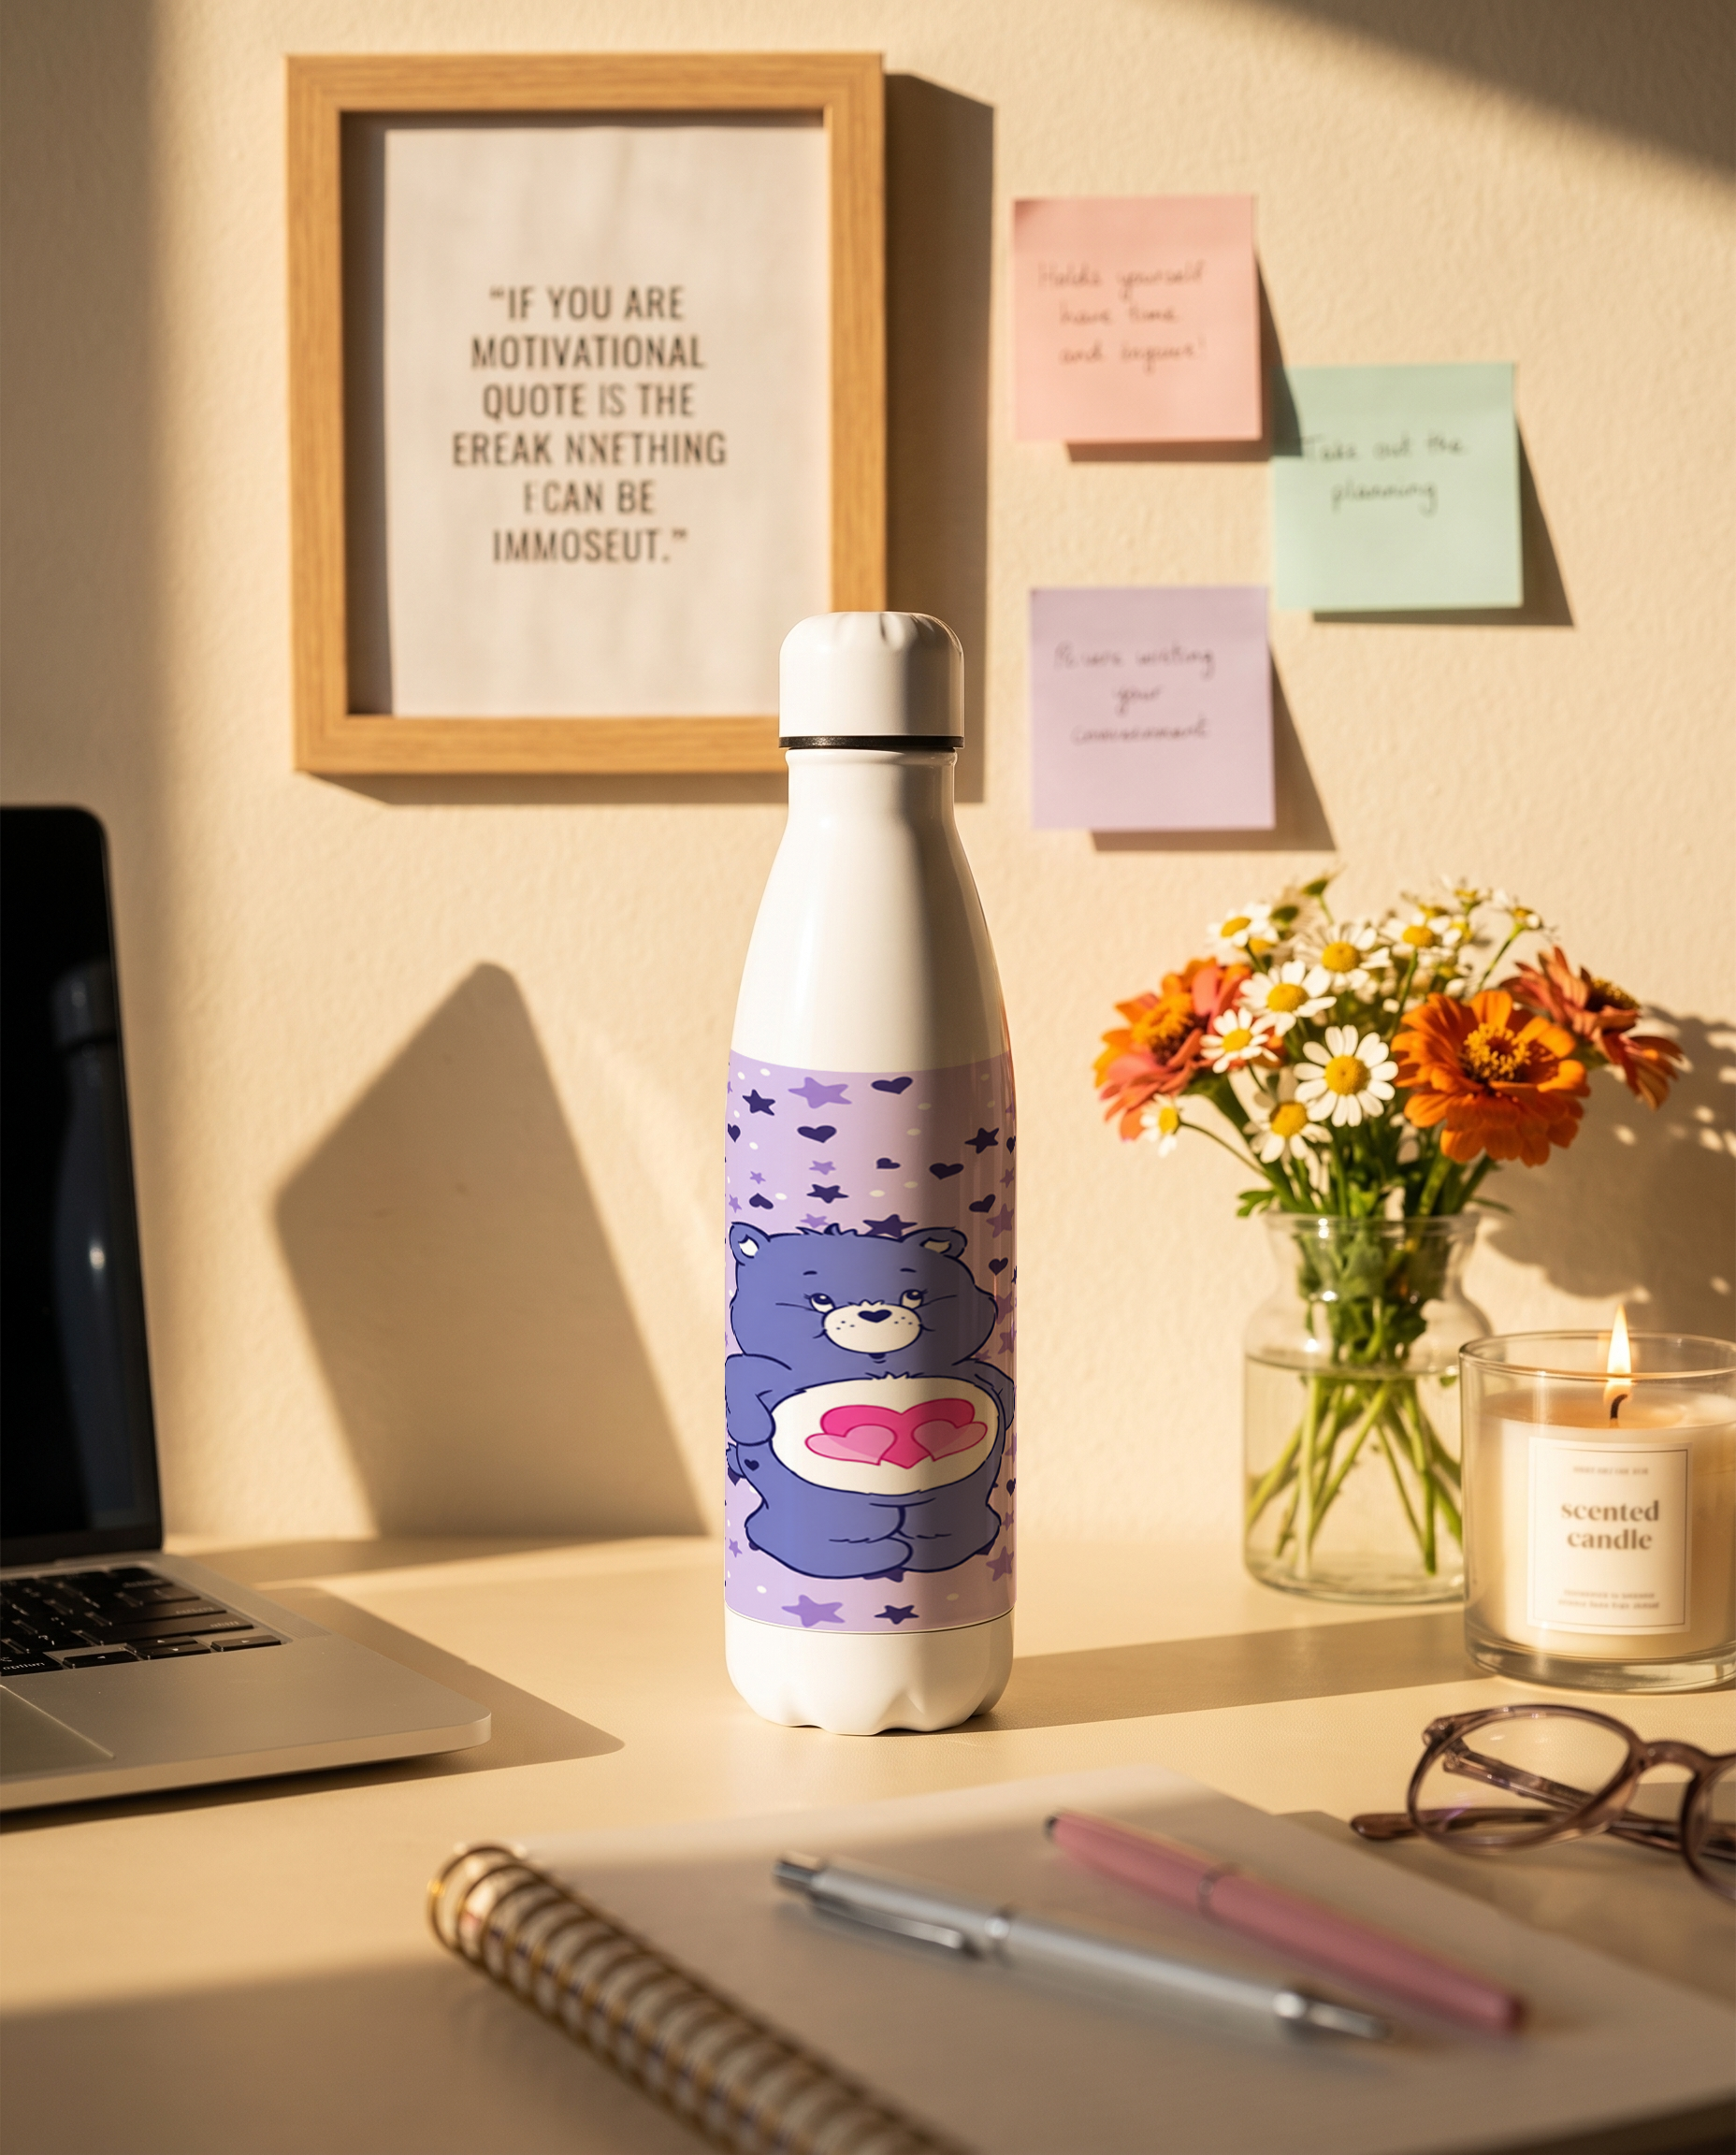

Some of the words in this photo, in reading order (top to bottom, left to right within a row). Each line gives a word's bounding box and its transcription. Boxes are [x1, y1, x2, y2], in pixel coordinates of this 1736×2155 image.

[547, 286, 613, 320] YOU
[625, 286, 684, 320] ARE
[472, 336, 705, 369] MOTIVATIONAL
[1059, 340, 1106, 365] and
[483, 383, 586, 421] QUOTE
[599, 383, 626, 417] IS
[639, 383, 694, 417] THE
[453, 432, 552, 466] EREAK
[1303, 434, 1359, 462] Take
[1374, 432, 1413, 459] out
[1427, 432, 1466, 456] the
[542, 482, 604, 513] CAN
[617, 481, 655, 513] BE
[1331, 479, 1439, 517] planning
[1560, 1499, 1660, 1522] scented
[1567, 1528, 1653, 1550] candle
